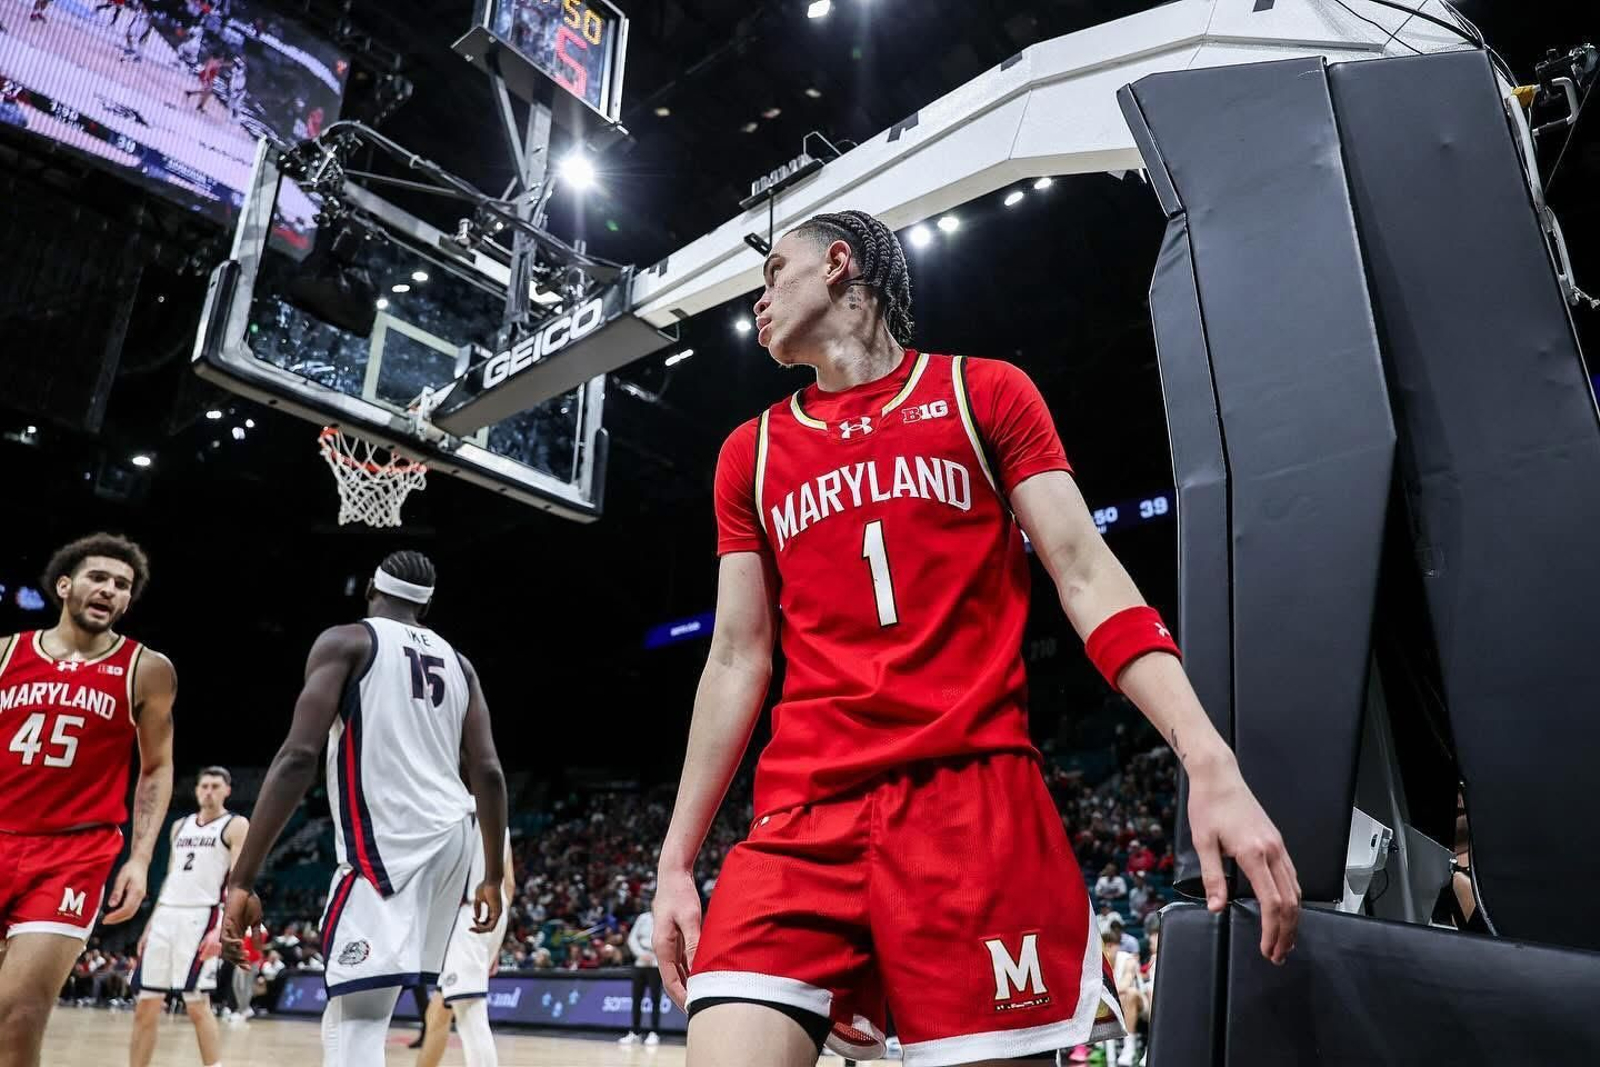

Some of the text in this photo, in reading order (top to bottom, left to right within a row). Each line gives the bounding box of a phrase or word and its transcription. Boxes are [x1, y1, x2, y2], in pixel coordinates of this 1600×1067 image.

[556, 25, 587, 98] 5
[482, 297, 603, 389] GEICO
[771, 455, 971, 551] MARYLAND
[1139, 497, 1168, 518] 39
[862, 520, 898, 627] 1
[0, 682, 116, 720] MARYLAND
[403, 646, 445, 708] 15
[9, 713, 85, 768] 45
[183, 852, 195, 871] 2
[57, 887, 87, 916] M
[985, 934, 1048, 1000] M
